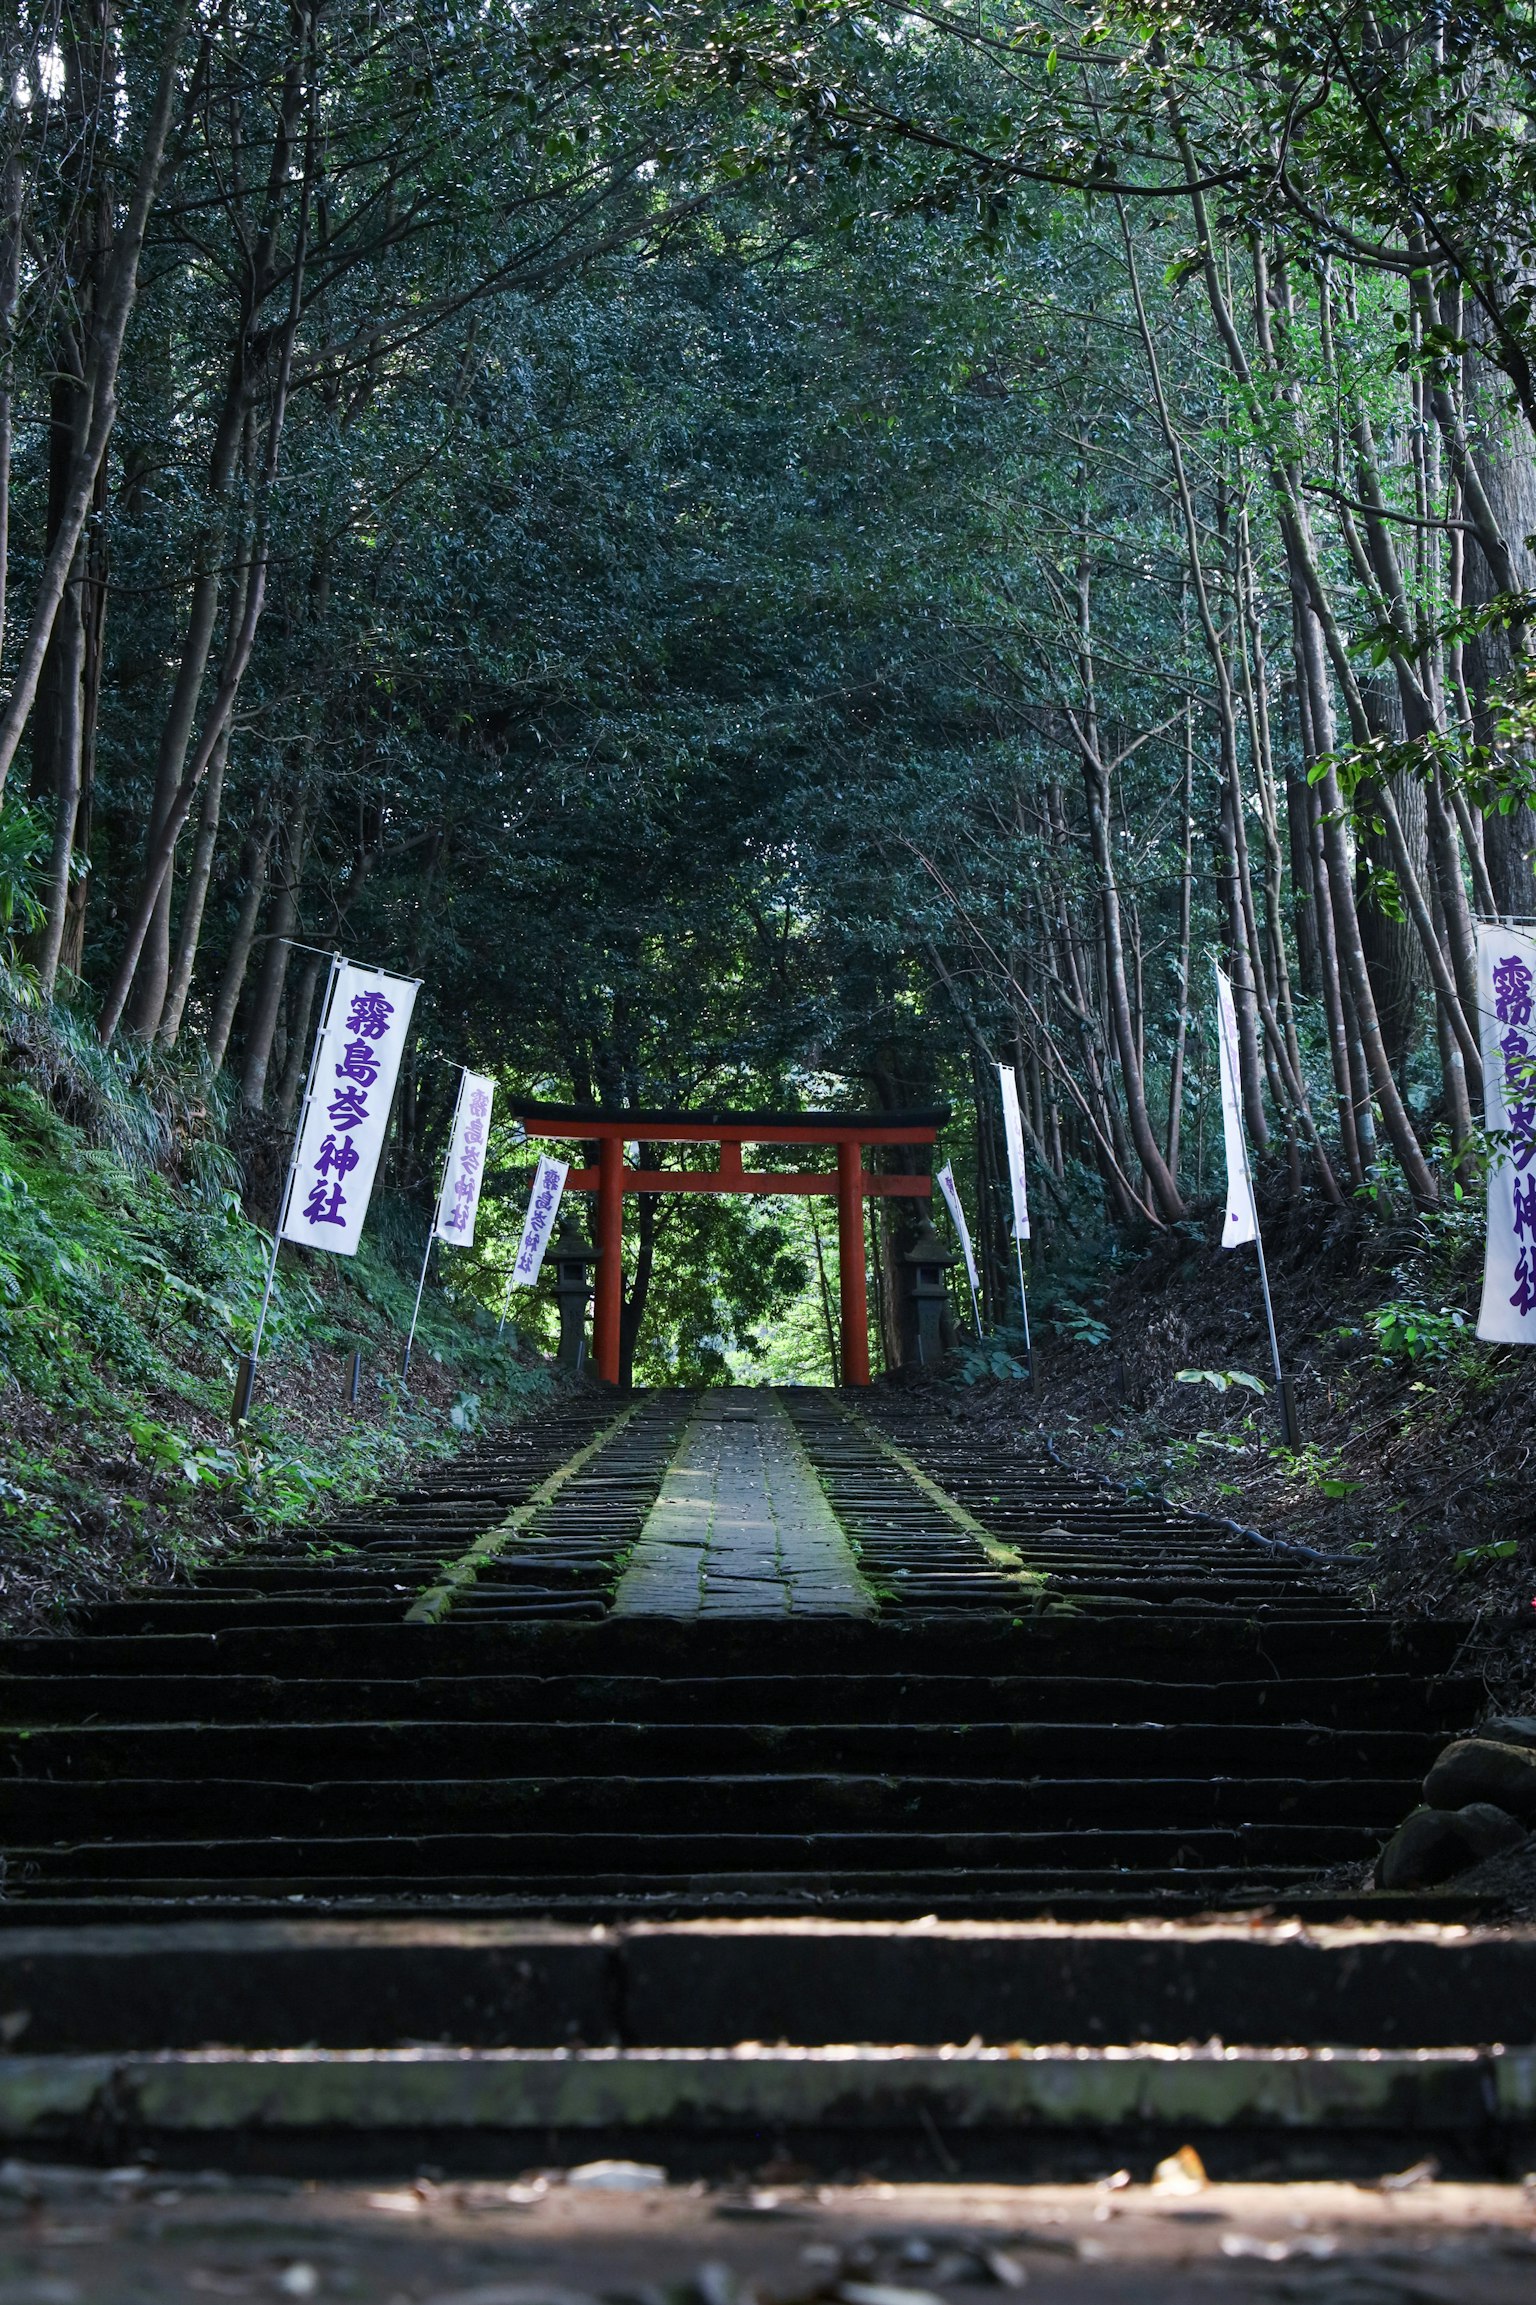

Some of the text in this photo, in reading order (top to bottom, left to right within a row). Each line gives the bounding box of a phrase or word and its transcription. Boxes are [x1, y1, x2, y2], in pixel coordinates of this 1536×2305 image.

[302, 990, 395, 1227] 霧島岑神社
